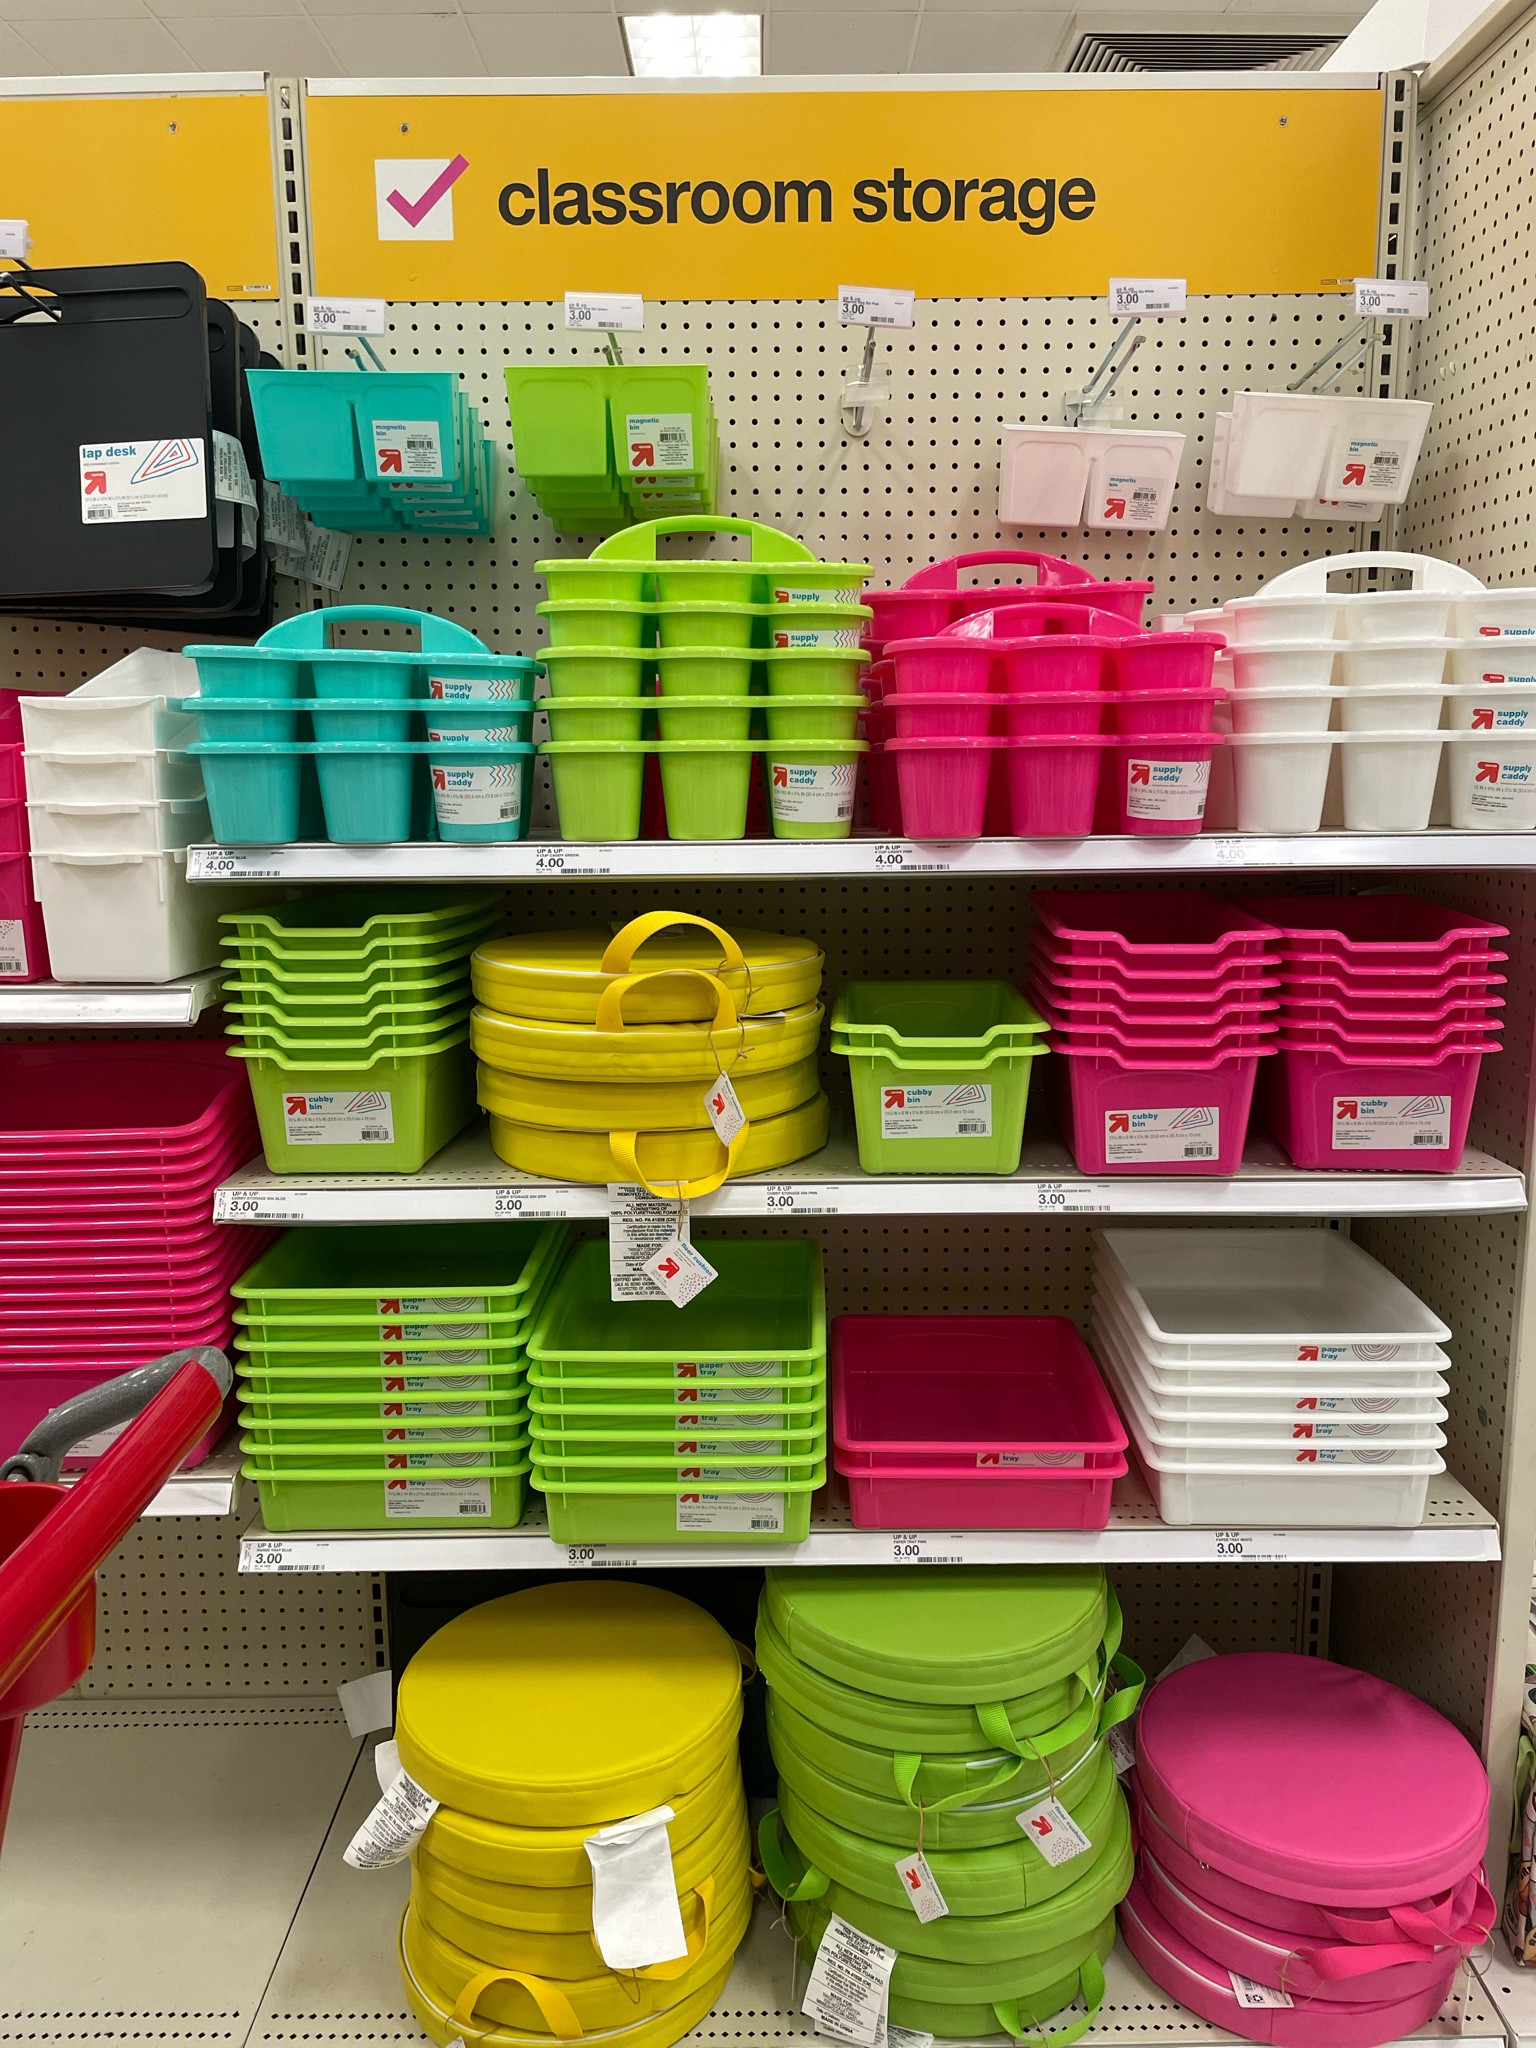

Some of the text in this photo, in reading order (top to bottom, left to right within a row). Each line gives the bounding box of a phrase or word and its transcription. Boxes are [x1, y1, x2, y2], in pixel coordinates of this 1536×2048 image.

[498, 168, 1097, 235] classroom storage
[1117, 294, 1138, 304] 3.00
[1360, 296, 1381, 306] 3.00
[843, 304, 864, 314] 3.00
[314, 313, 336, 323] 3.00
[569, 310, 591, 320] 3.00
[82, 446, 137, 461] lap desk
[790, 634, 819, 642] supply
[444, 683, 472, 692] supply
[1497, 710, 1529, 718] supply
[1496, 719, 1525, 727] caddy
[442, 734, 469, 742] supply
[789, 768, 817, 777] supply
[1152, 766, 1183, 774] supply
[1502, 764, 1532, 773] supply
[446, 770, 474, 779] supply
[1152, 774, 1180, 783] caddy
[1501, 773, 1528, 781] caddy
[447, 779, 472, 787] caddy
[789, 777, 815, 785] caddy
[875, 854, 903, 864] 4.00
[1216, 849, 1245, 859] 4.00
[206, 860, 234, 870] 4.00
[535, 857, 564, 867] 4.00
[767, 1196, 794, 1207] 3.00
[1038, 1194, 1065, 1204] 3.00
[230, 1201, 258, 1211] 3.00
[495, 1200, 522, 1210] 3.00
[681, 1242, 694, 1257] floor
[693, 1255, 714, 1277] cushion
[893, 1545, 920, 1555] 3.00
[1216, 1543, 1242, 1553] 3.00
[255, 1553, 282, 1563] 3.00
[569, 1549, 595, 1559] 3.00
